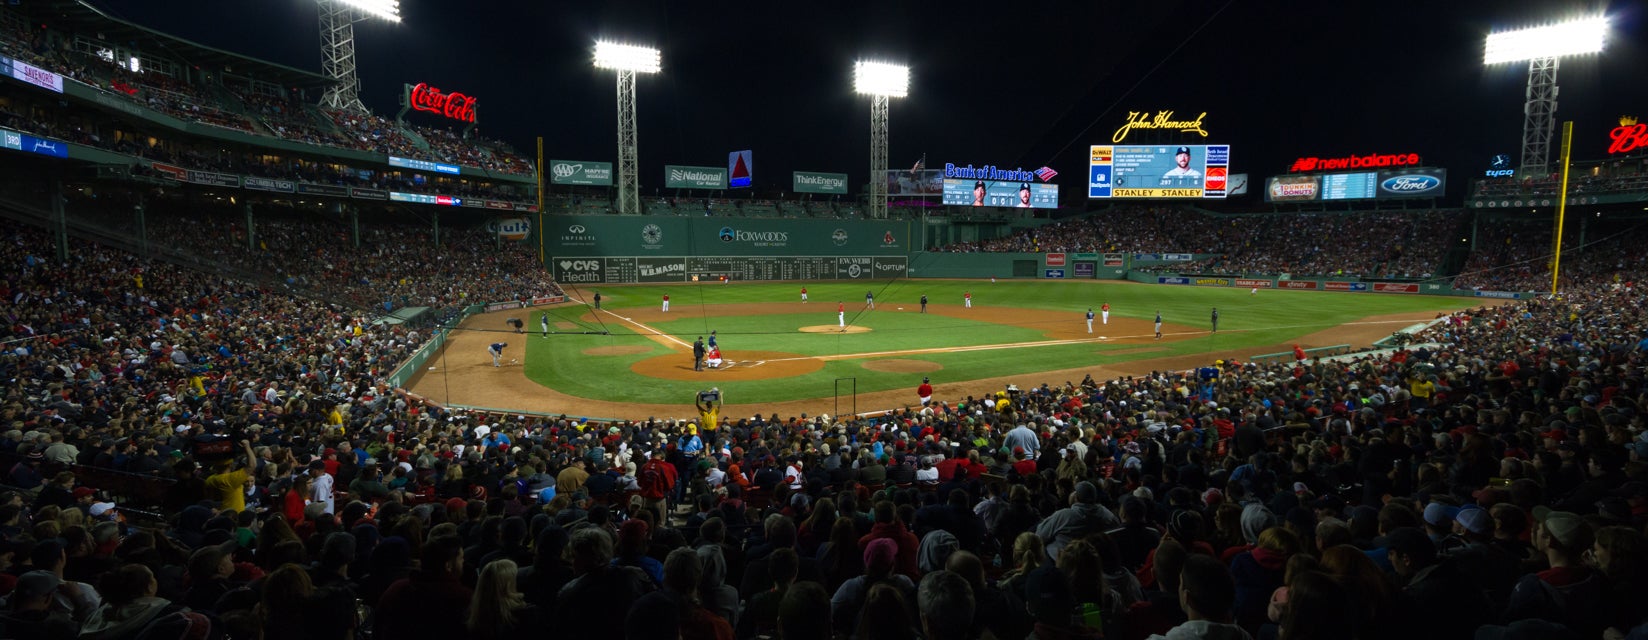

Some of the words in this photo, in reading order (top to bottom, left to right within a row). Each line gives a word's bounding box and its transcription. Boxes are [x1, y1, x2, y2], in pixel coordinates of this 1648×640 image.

[411, 82, 476, 122] Coca-Cola
[1112, 110, 1153, 142] John
[1153, 110, 1208, 137] Hancock
[7, 135, 20, 145] 3RD
[1318, 159, 1350, 169] new
[1350, 153, 1419, 168] balance
[683, 171, 722, 181] National
[945, 163, 975, 178] Bank
[976, 165, 988, 179] of
[989, 165, 1034, 182] America
[1485, 169, 1514, 178] tyco
[796, 175, 843, 187] ThinkEnergy
[1391, 177, 1428, 190] Ford
[736, 229, 788, 242] FOXWOODS
[572, 260, 600, 271] CVS
[561, 271, 601, 282] Health
